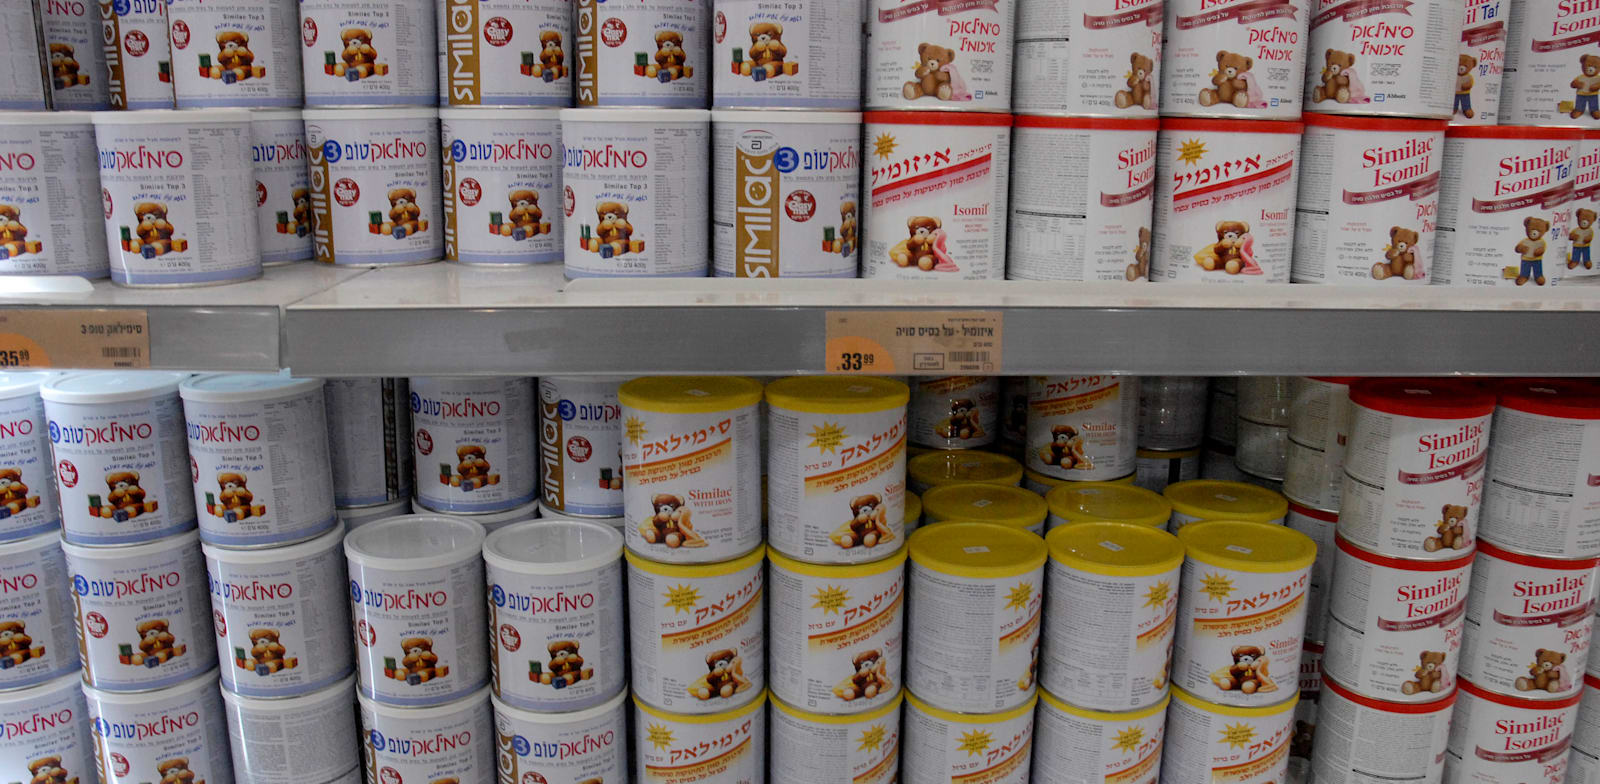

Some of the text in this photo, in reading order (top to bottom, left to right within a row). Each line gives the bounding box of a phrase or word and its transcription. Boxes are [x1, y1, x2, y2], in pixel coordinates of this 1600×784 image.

[1482, 2, 1499, 20] Taf
[777, 150, 795, 171] 3
[1362, 136, 1434, 168] Similac
[1499, 146, 1572, 177] Similac
[872, 147, 951, 187] איזומיל
[1173, 154, 1261, 192] איזומיל
[1373, 156, 1429, 187] Isomil
[1494, 161, 1573, 196] Isomil Taf
[953, 204, 988, 216] Isomil
[81, 323, 142, 336] סימילאק טופ 3
[895, 323, 994, 337] איזומיל על בסיס סויה
[0, 350, 19, 367] 35
[841, 353, 874, 371] 33 99
[642, 418, 732, 461] סימילאק
[1418, 422, 1484, 453] Similac
[1429, 438, 1480, 470] Isomil
[688, 488, 732, 500] Similac
[1397, 572, 1464, 601] Similac
[1513, 573, 1587, 598] Similac
[1407, 588, 1458, 618] Isomil
[1521, 590, 1583, 614] Isomil
[1495, 712, 1565, 736] Similac
[670, 720, 751, 764] סימילאק
[1504, 728, 1559, 751] Isomil
